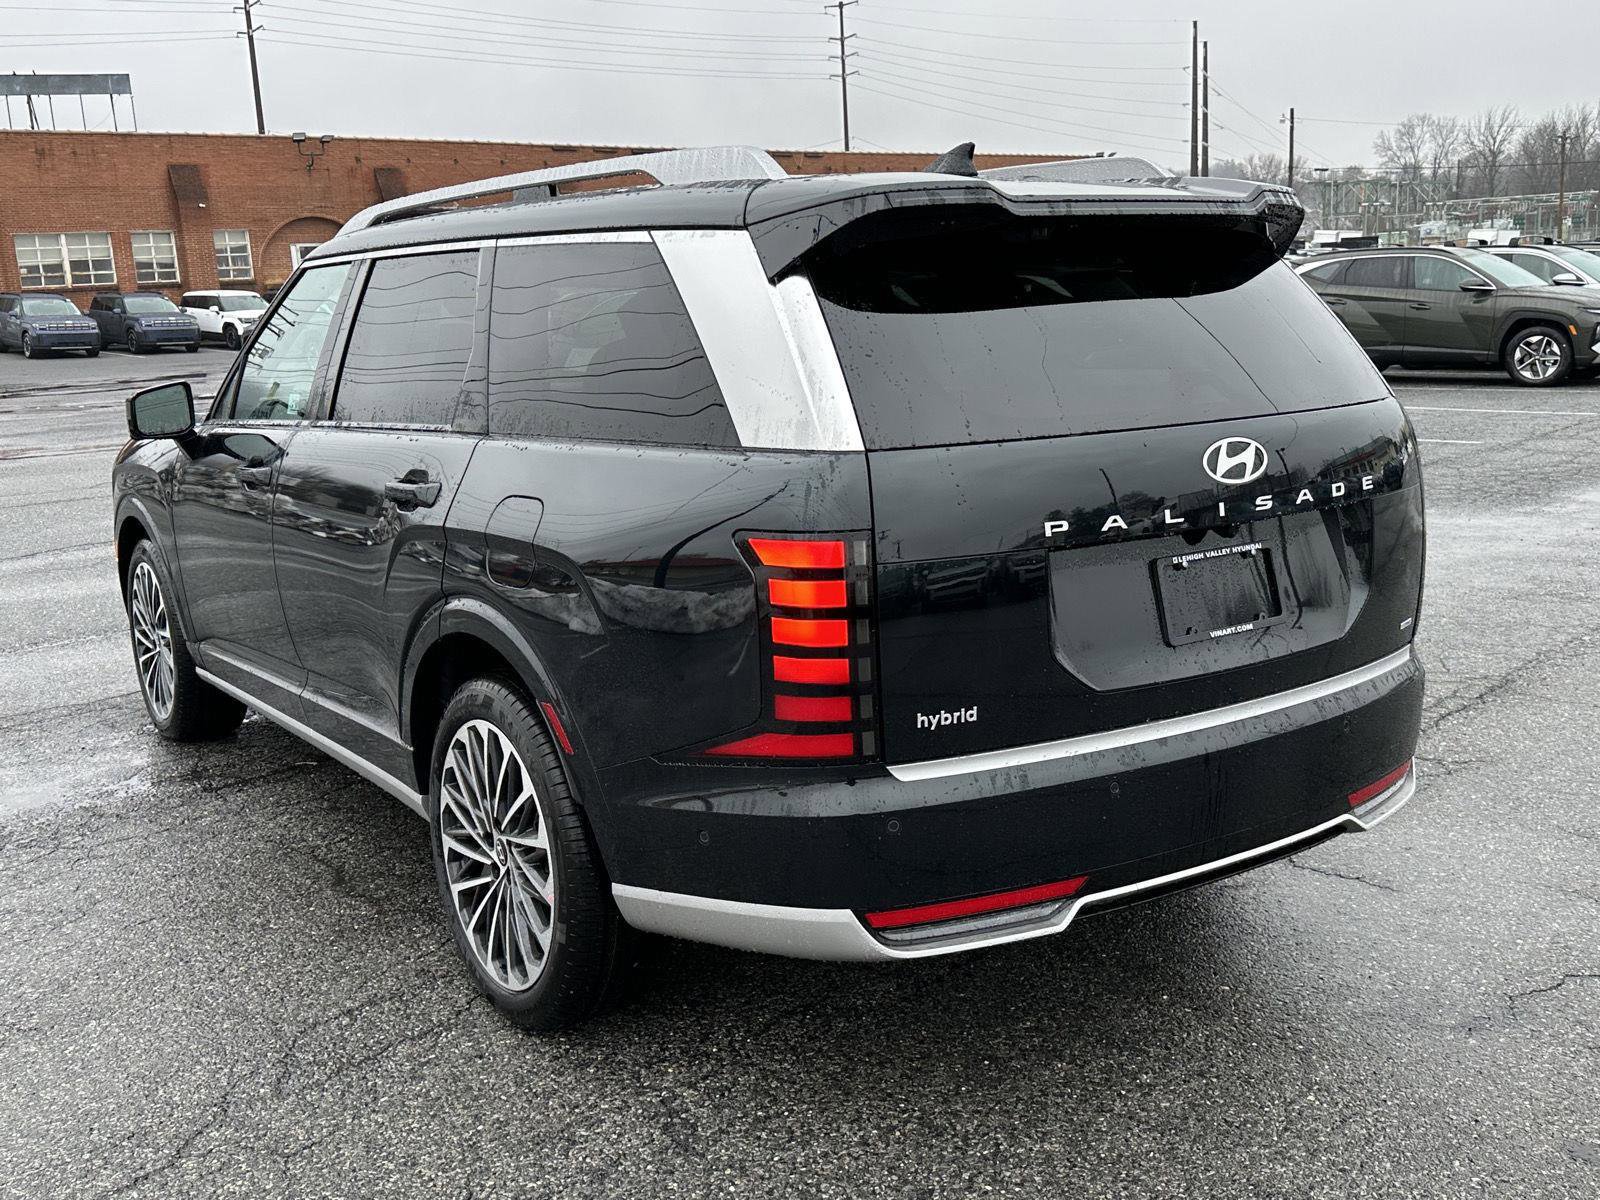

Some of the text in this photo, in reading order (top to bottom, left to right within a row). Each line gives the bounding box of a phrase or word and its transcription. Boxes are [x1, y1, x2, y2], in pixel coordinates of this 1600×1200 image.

[1044, 475, 1374, 537] PALISADE
[1178, 542, 1262, 563] LEHIGH VALLEY HYUNDAI
[1209, 623, 1254, 638] VINART.COM
[917, 705, 978, 731] hybrid
